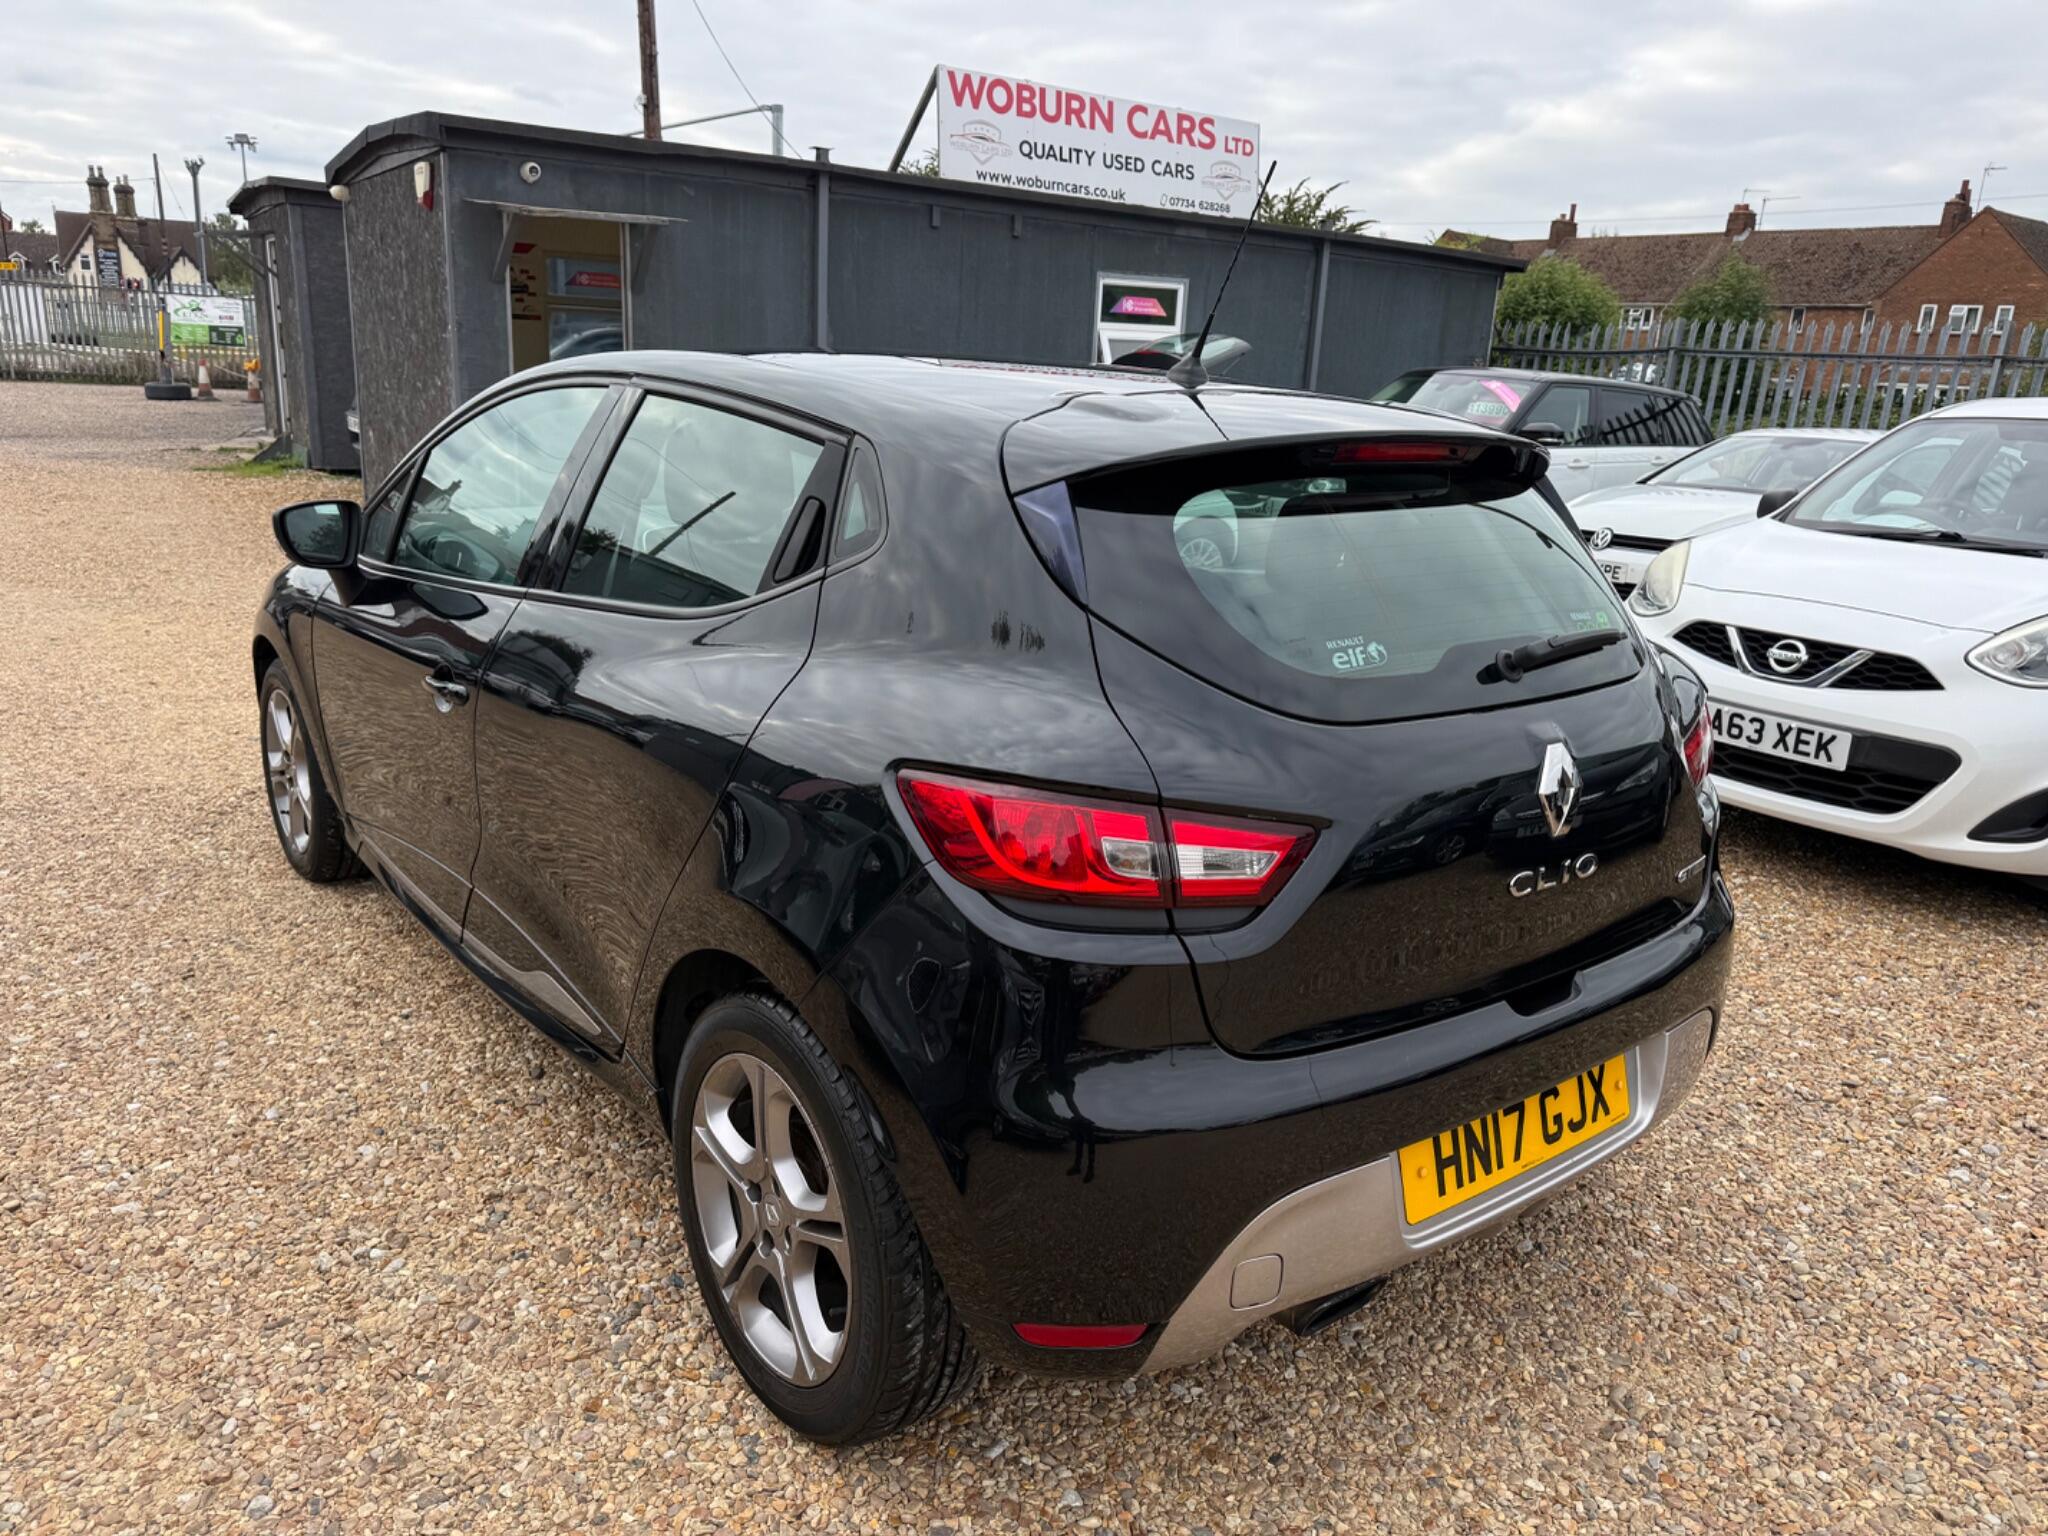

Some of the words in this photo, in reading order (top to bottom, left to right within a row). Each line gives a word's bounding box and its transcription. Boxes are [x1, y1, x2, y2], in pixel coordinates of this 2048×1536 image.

[947, 70, 1114, 133] WOBURN
[1127, 104, 1216, 150] CARS
[1224, 135, 1254, 157] LTD
[1019, 140, 1096, 166] QUALITY
[1103, 151, 1145, 173] USED
[1151, 159, 1195, 180] CARS
[976, 170, 1126, 200] www.woburncars.co.uk
[1169, 197, 1196, 208] 07734
[1600, 564, 1622, 580] PE
[1332, 646, 1366, 669] elf
[1772, 722, 1838, 763] XEK
[1508, 853, 1598, 898] CLIO
[1432, 1101, 1526, 1198] HN17
[1539, 1063, 1611, 1146] GJX
